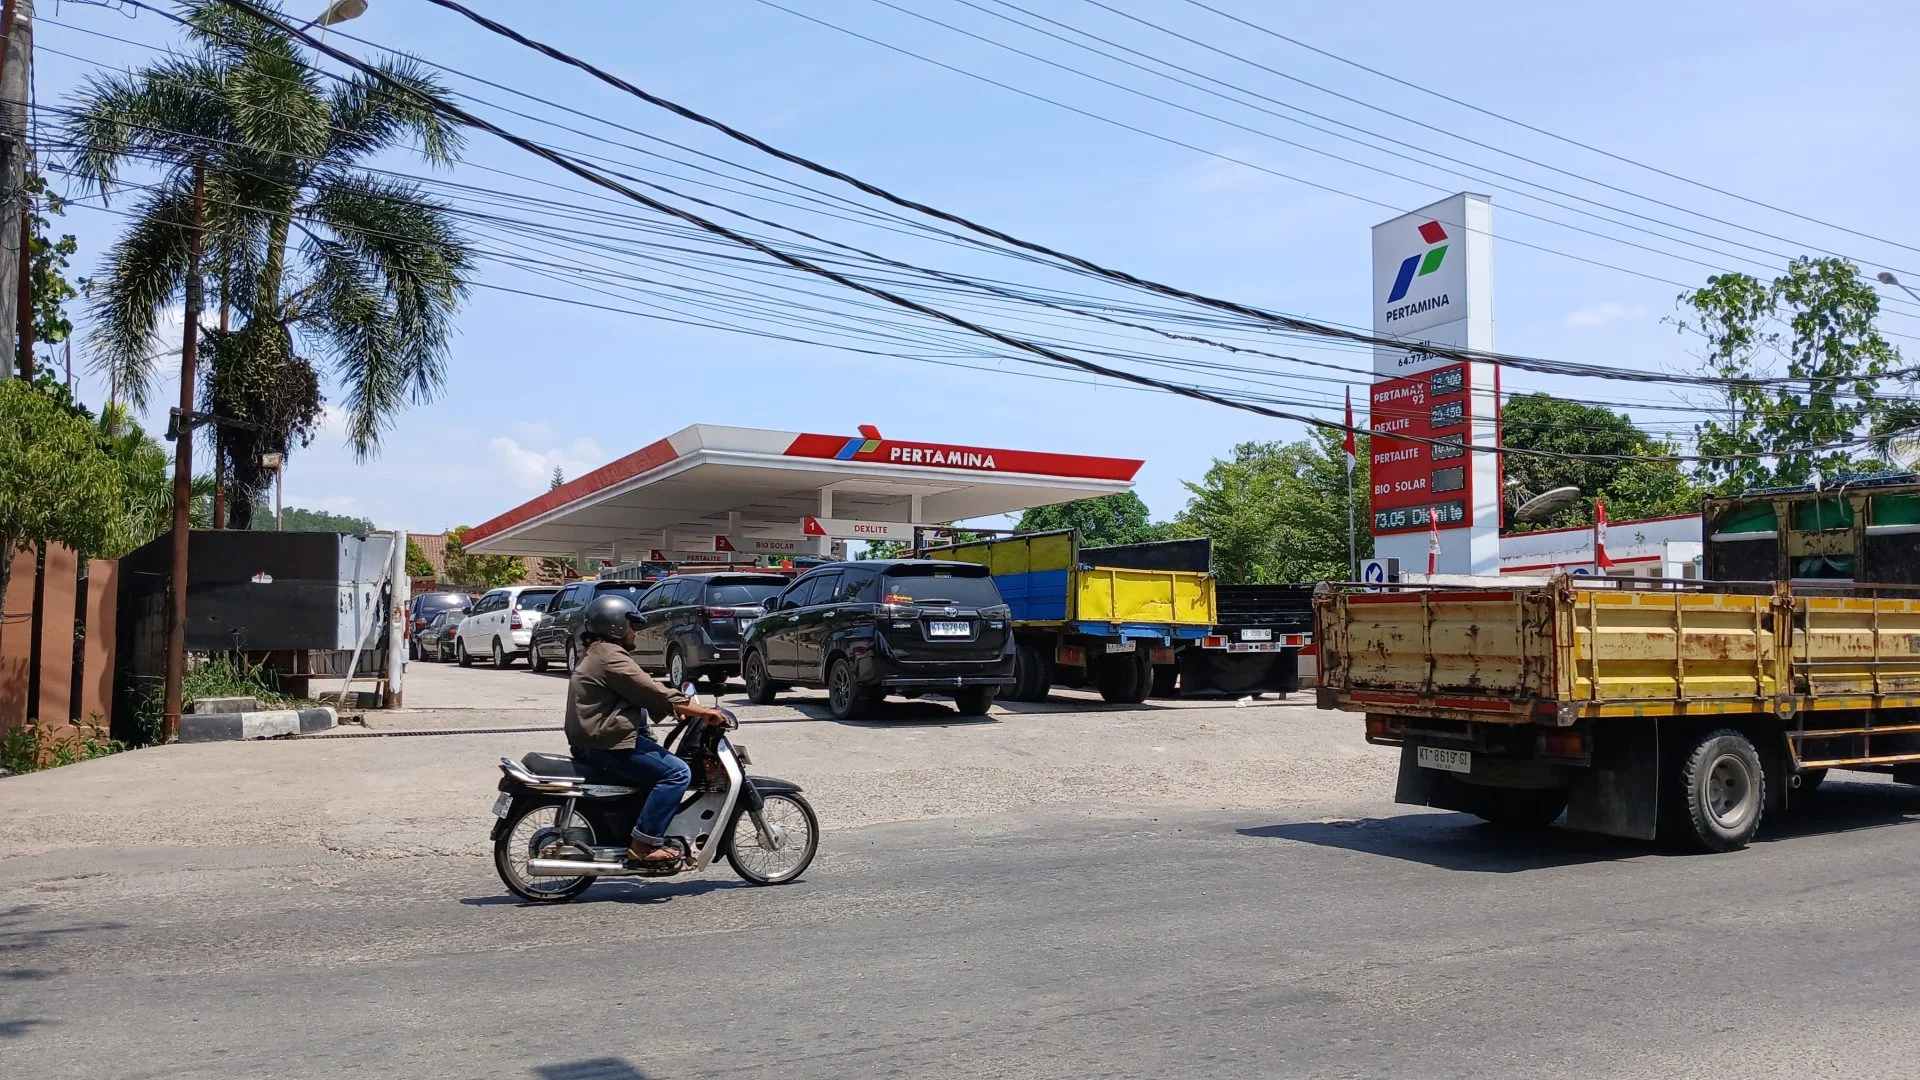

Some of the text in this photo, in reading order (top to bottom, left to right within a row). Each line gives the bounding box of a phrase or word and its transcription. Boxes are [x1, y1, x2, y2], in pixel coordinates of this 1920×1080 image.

[1386, 293, 1450, 323] PERTAMINA
[1398, 351, 1438, 367] 64.773.0
[1374, 383, 1424, 404] PERTAMAX
[1412, 394, 1425, 406] 92
[1374, 418, 1410, 433] DEXLITE
[890, 447, 996, 469] PERTAMINA
[1374, 447, 1419, 464] PERTALITE
[1374, 478, 1426, 495] BIO SOLAR
[809, 521, 815, 531] 1
[854, 524, 888, 534] DEXLITE
[719, 539, 725, 547] 2
[755, 541, 794, 550] BIO SOLAR
[686, 554, 721, 562] PERTALITE
[1420, 748, 1429, 760] KT
[1434, 749, 1456, 763] 8619
